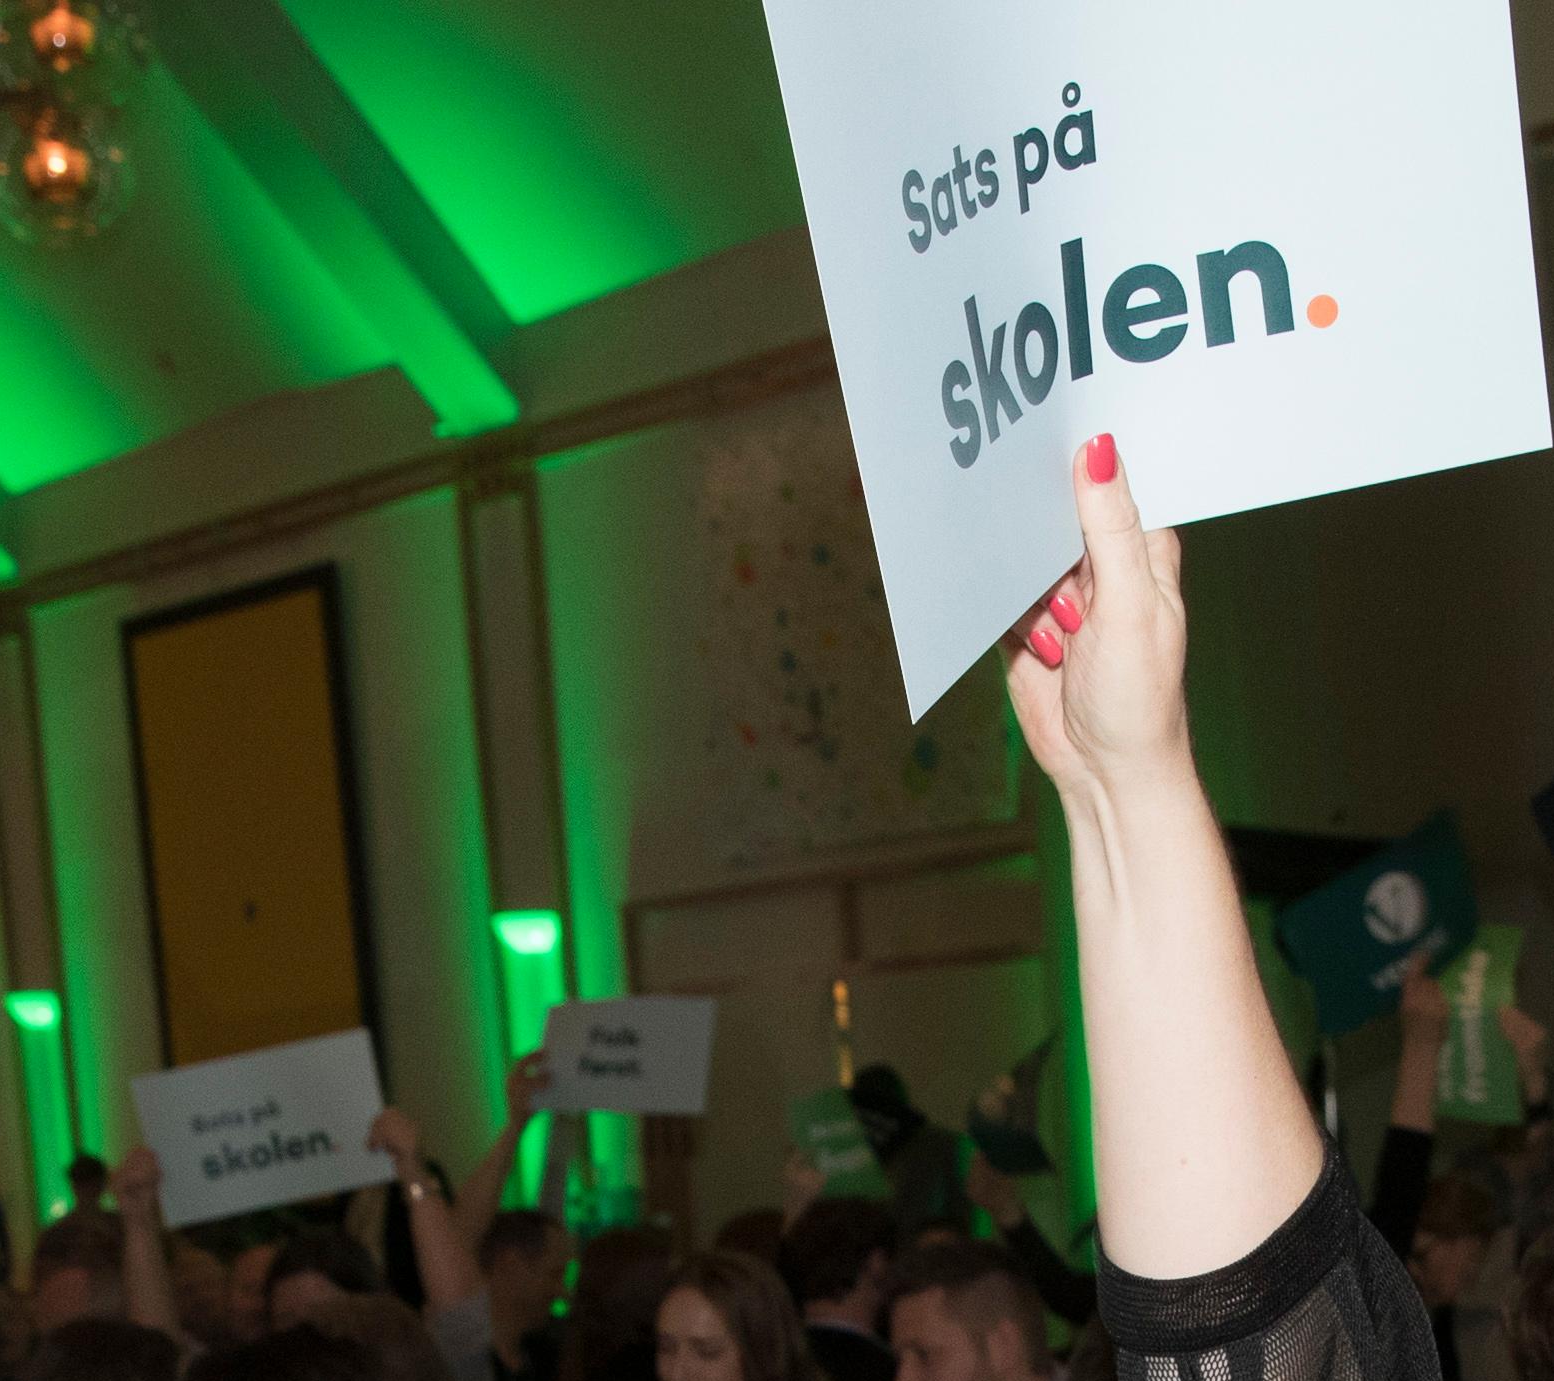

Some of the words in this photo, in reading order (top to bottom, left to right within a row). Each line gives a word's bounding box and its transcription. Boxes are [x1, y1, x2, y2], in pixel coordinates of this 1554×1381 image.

[901, 144, 1000, 254] Sats
[1013, 82, 1097, 214] på
[941, 237, 1339, 469] skolen.
